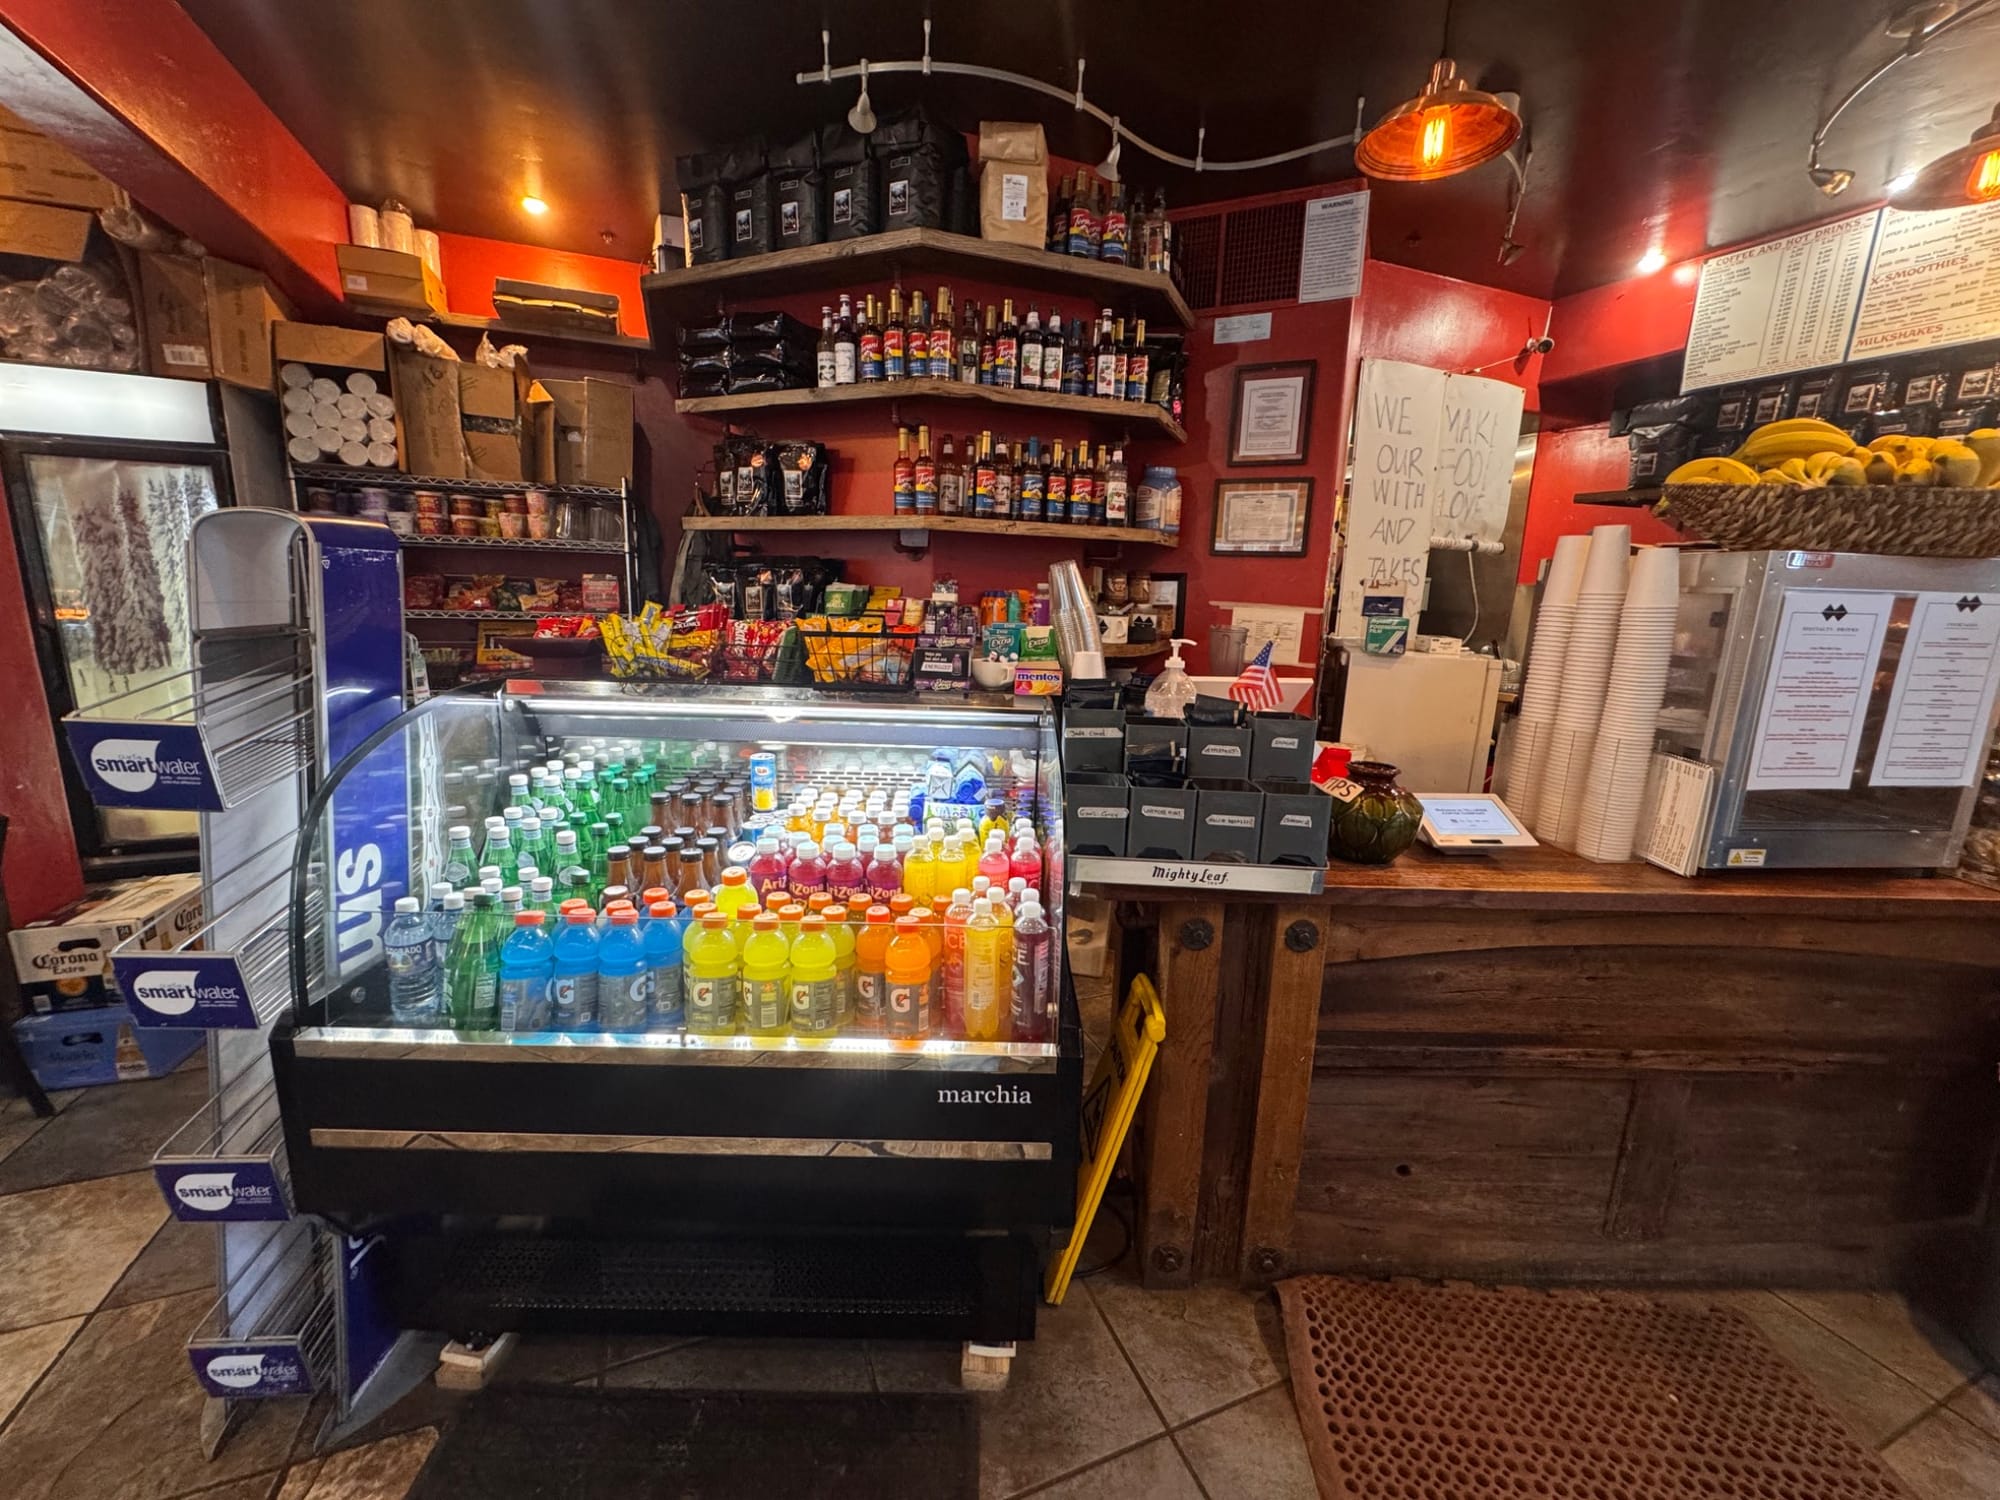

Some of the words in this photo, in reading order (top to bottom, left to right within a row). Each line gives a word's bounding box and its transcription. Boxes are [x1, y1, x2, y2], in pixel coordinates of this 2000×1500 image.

[1716, 250, 1756, 267] COFFEE
[1757, 241, 1782, 256] AND
[1785, 234, 1811, 249] HOT
[1813, 218, 1862, 239] DRINKS
[1870, 254, 1969, 287] X-SMOOTHIES
[1854, 323, 1944, 348] MILKSHAKES
[1374, 392, 1412, 435] WE
[1377, 444, 1424, 479] OUR
[1373, 479, 1426, 510] WITH
[1370, 518, 1415, 545] AND
[1368, 556, 1420, 587] TAKES
[1017, 672, 1060, 682] mentos
[95, 757, 200, 775] smartwater
[1152, 864, 1199, 883] Mighty
[1199, 867, 1229, 884] Leaf
[32, 951, 99, 970] Corona
[52, 965, 86, 976] Extra
[138, 984, 238, 1000] smartwater
[556, 980, 575, 1004] G
[692, 981, 713, 1008] G
[792, 983, 809, 1010] G
[890, 988, 911, 1013] G
[937, 1085, 1032, 1104] marchia
[178, 1185, 271, 1199] smartwater
[211, 1364, 298, 1377] smartwater
